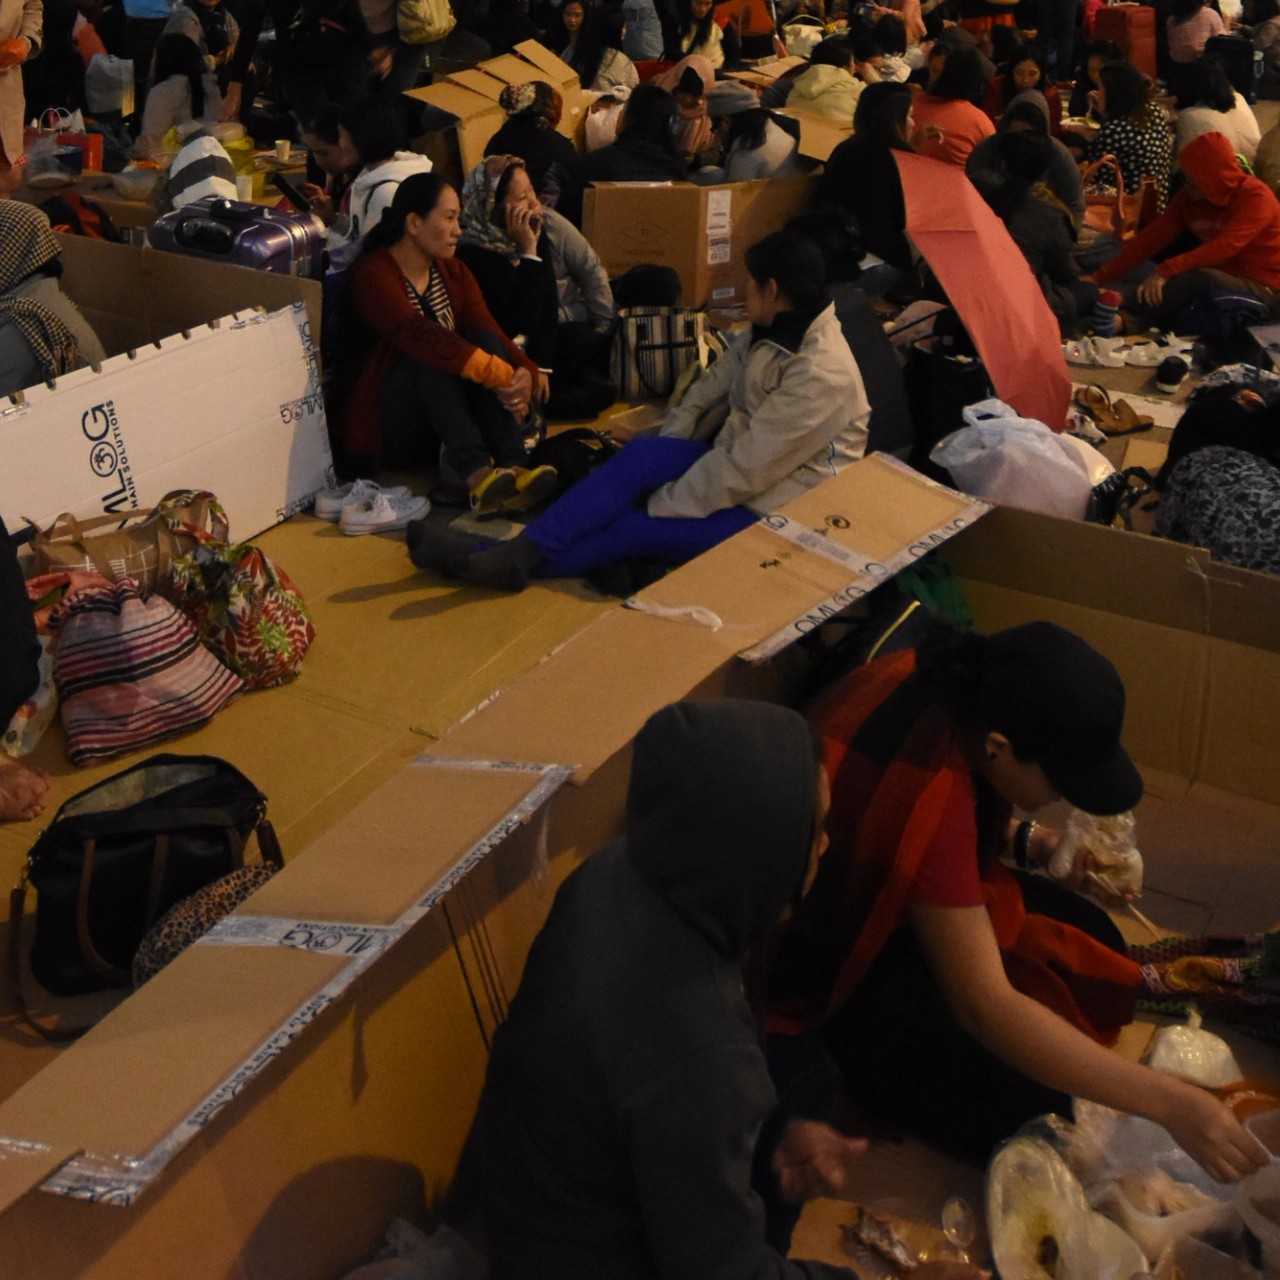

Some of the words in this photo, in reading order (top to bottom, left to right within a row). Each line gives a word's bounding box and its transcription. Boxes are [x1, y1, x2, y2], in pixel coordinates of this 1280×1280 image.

[105, 399, 131, 473] SOLUTIONS
[250, 1027, 287, 1063] CHAIN
[185, 1061, 252, 1129] SOLUTIONS
